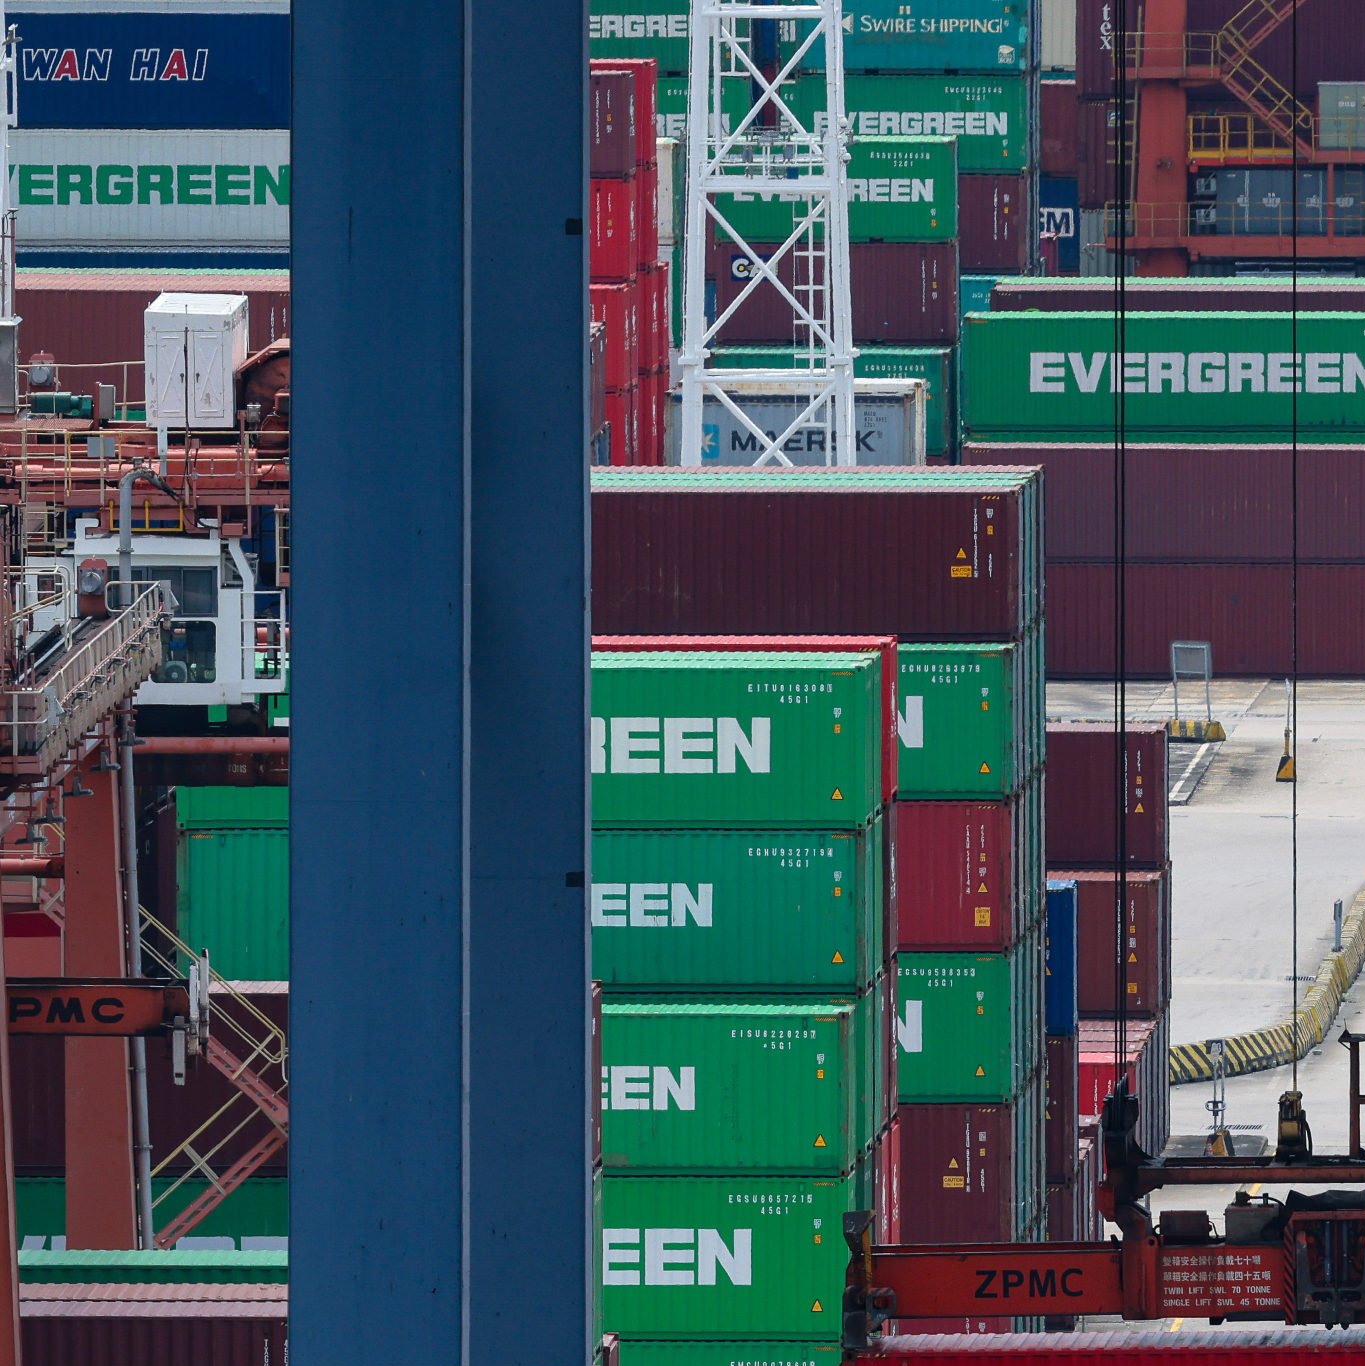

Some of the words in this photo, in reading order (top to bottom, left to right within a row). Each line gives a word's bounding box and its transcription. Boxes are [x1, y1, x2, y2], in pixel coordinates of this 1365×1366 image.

[22, 48, 113, 81] WAN
[130, 48, 209, 81] HAI
[9, 164, 290, 206] ERGREEN
[780, 695, 809, 704] 45G1
[780, 858, 809, 869] 45G1
[760, 1206, 790, 1216] 45G1
[974, 1267, 1085, 1299] ZPMC
[1163, 1286, 1185, 1296] TWIN
[1188, 1286, 1205, 1296] LIFT
[1209, 1286, 1227, 1296] SWL
[1231, 1286, 1242, 1296] 70
[1245, 1286, 1272, 1296] TONNE
[1163, 1298, 1190, 1308] SINGLE
[1195, 1298, 1212, 1308] LIFT
[1216, 1298, 1236, 1308] SWL
[1239, 1298, 1251, 1308] 45
[1254, 1298, 1282, 1307] TONNE
